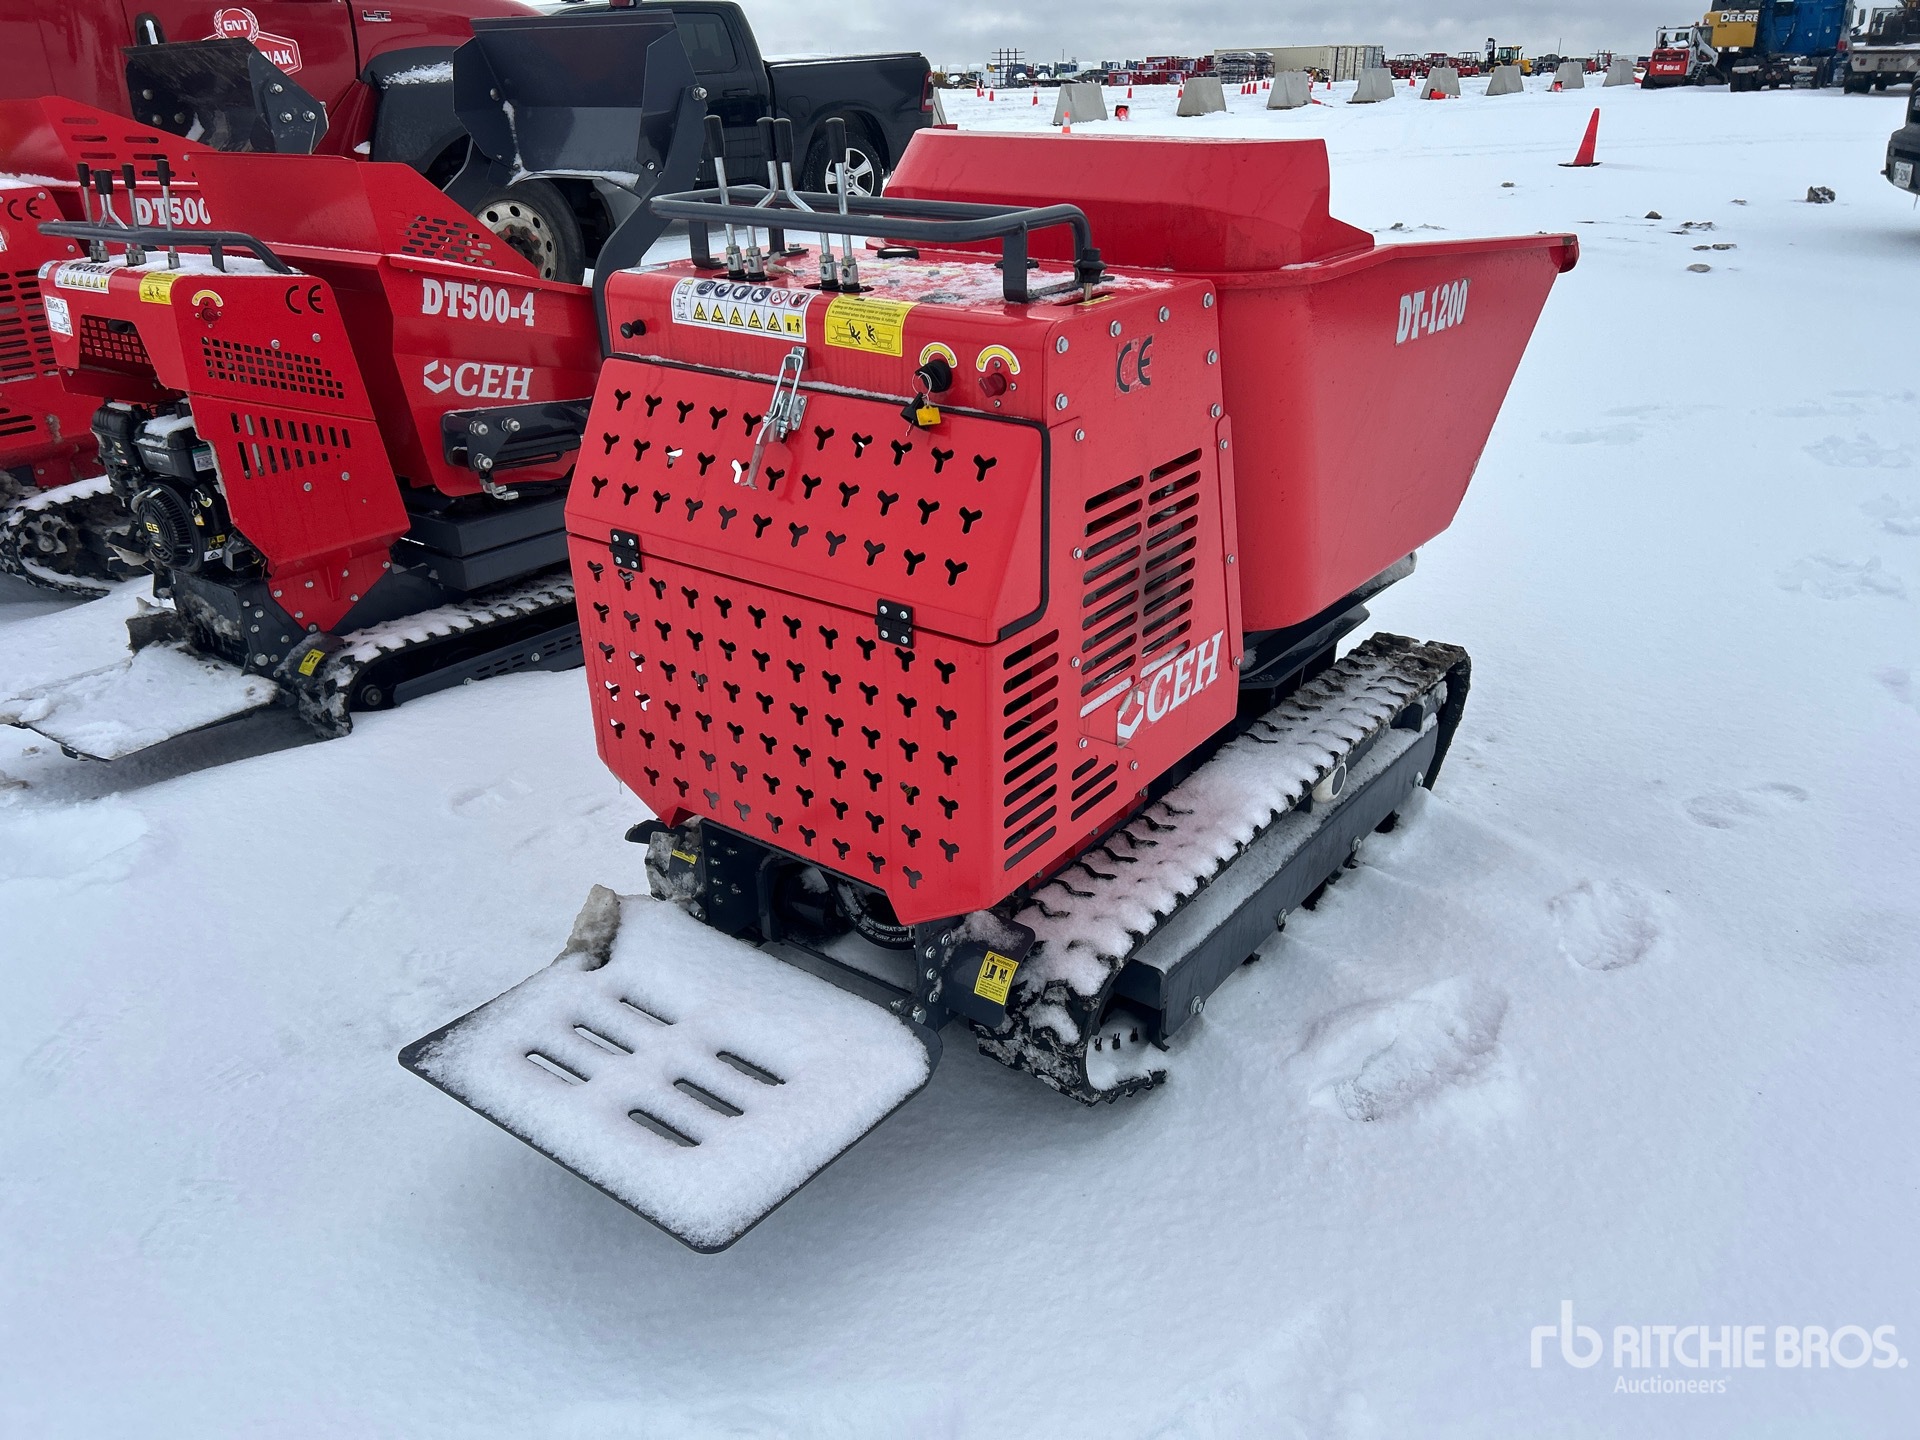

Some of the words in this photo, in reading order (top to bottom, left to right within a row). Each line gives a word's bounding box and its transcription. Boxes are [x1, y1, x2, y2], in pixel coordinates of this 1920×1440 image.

[223, 19, 248, 31] GNT
[1720, 12, 1759, 23] DEERE
[422, 278, 535, 327] DT500-4
[1395, 279, 1469, 344] DT-1200
[454, 361, 534, 401] CEH
[1146, 629, 1224, 722] CEH
